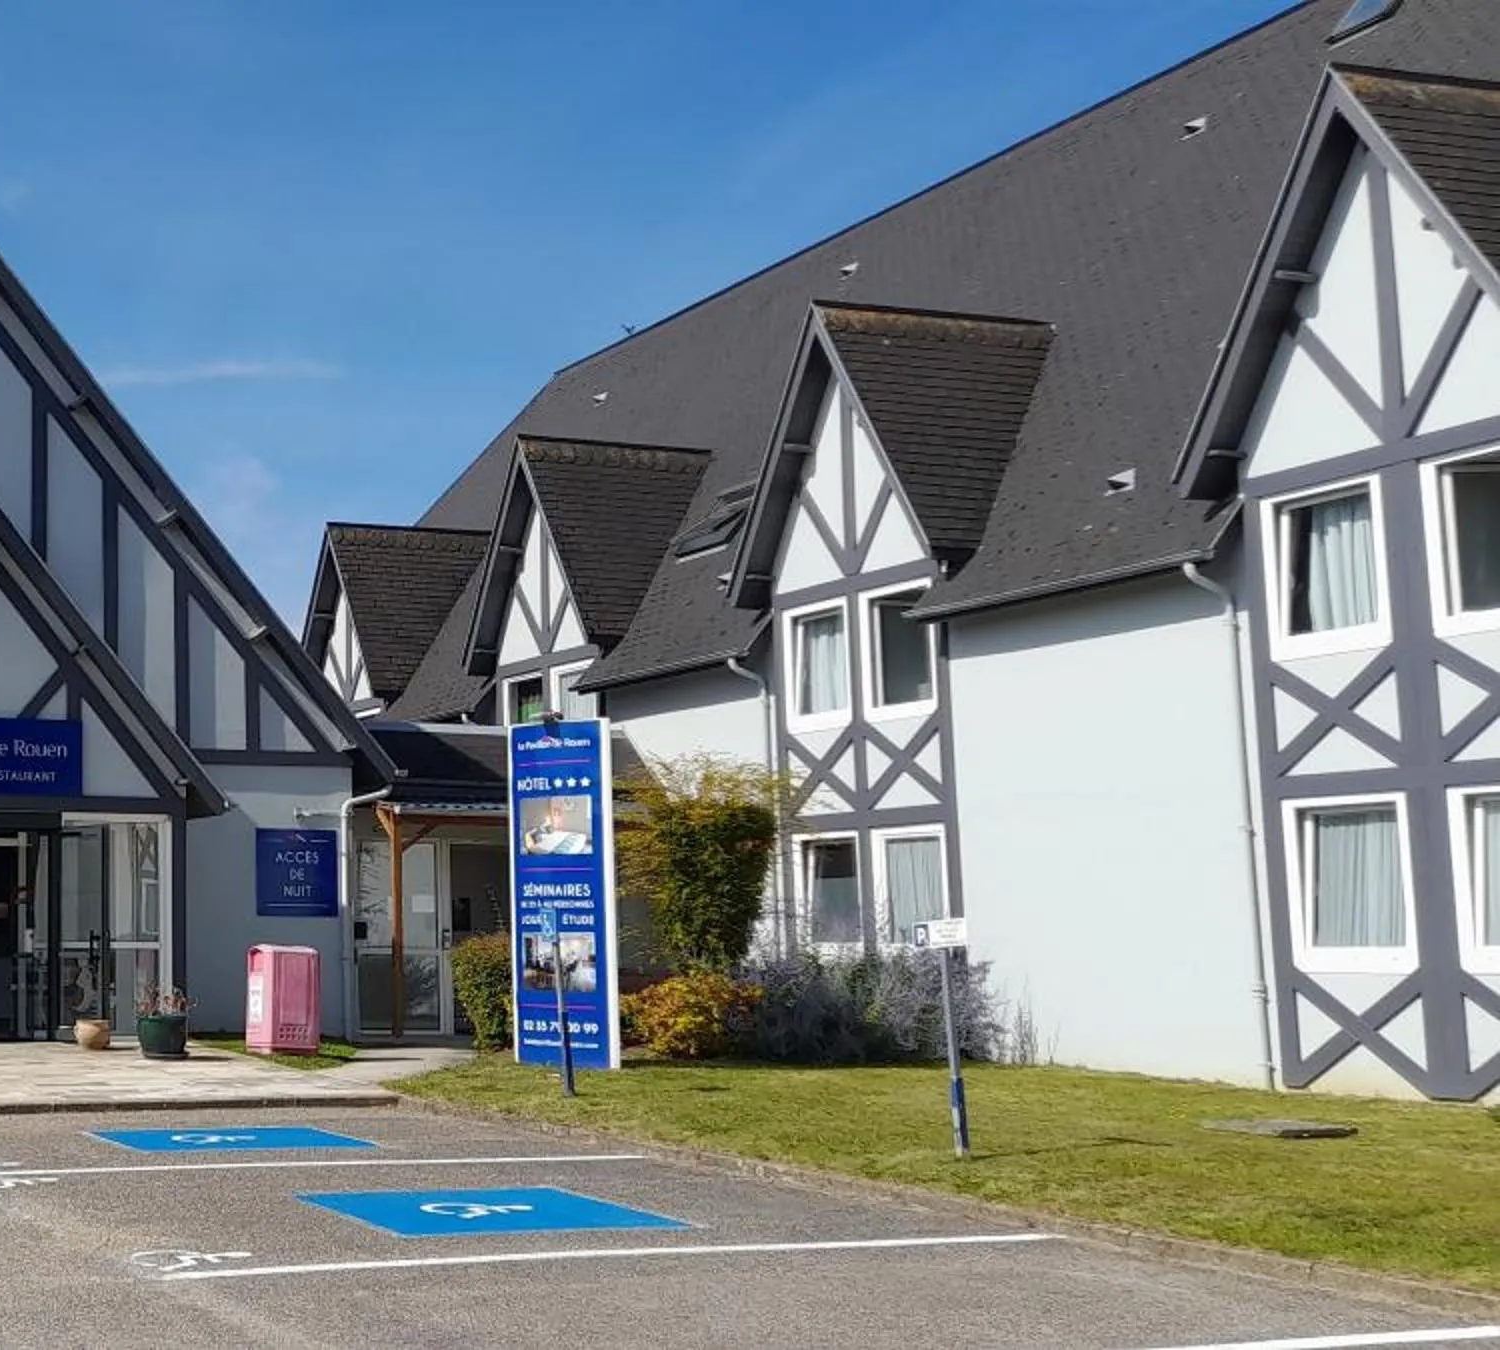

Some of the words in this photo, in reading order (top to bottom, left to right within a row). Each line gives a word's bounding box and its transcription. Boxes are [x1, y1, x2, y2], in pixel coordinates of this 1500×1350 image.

[13, 739, 68, 759] Rouen
[517, 776, 551, 792] HÔTEL
[289, 867, 305, 881] DE
[283, 885, 313, 897] NUIT
[522, 881, 592, 897] SÉMINAIRES
[916, 927, 926, 945] P
